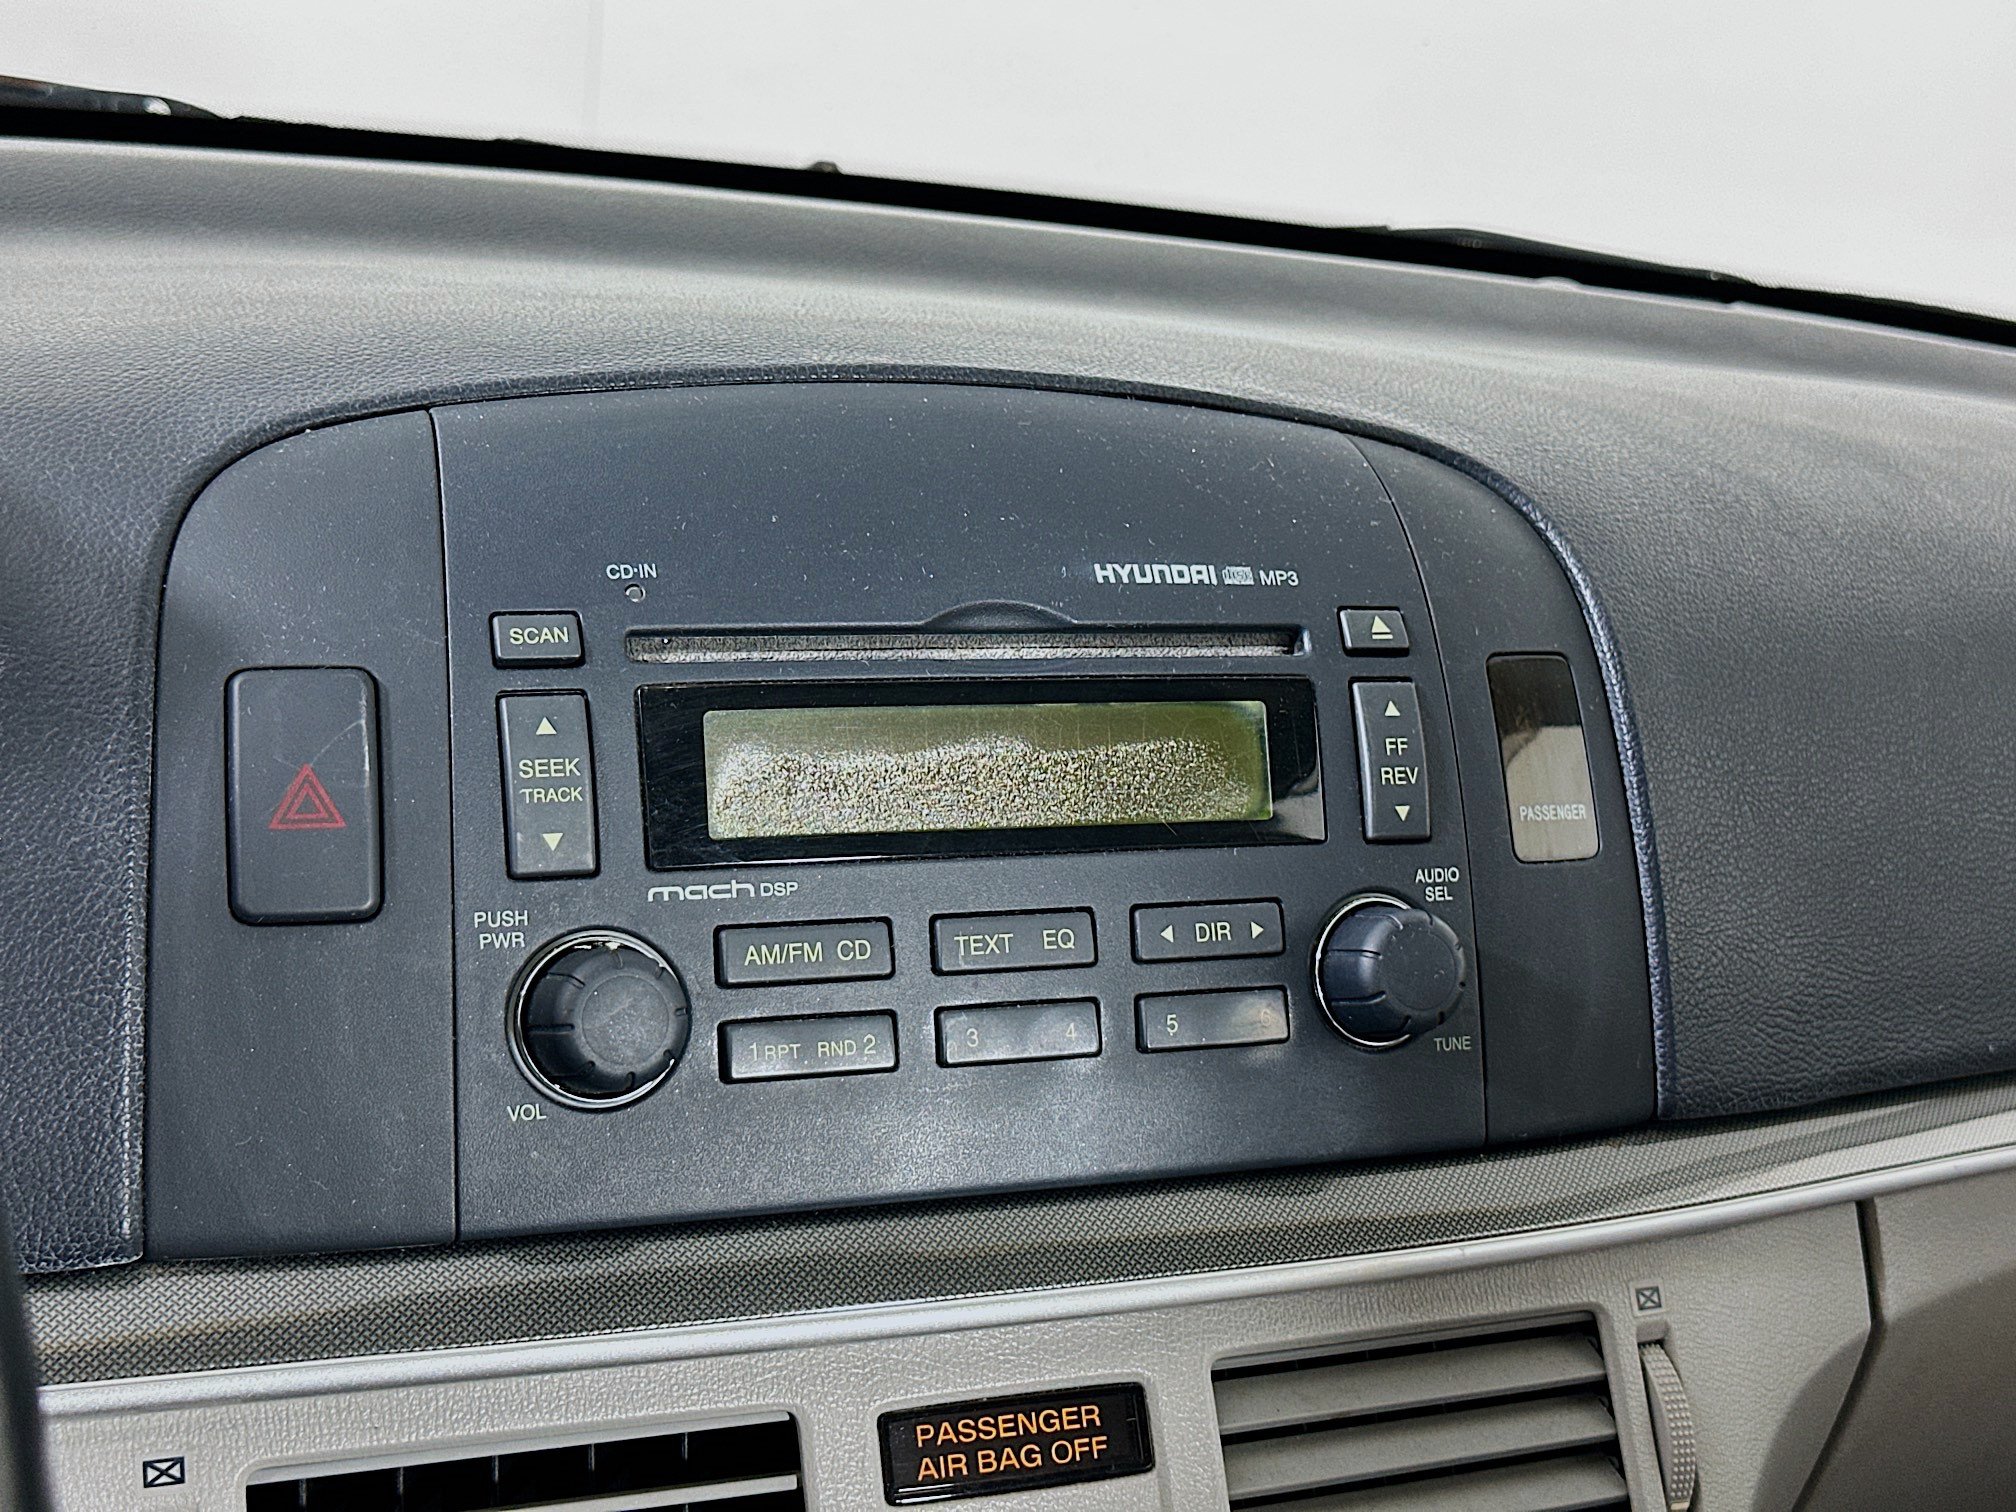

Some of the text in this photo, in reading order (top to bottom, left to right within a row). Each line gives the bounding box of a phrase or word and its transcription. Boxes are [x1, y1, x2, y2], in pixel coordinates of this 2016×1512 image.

[1094, 563, 1217, 586] HYUNDAI
[1259, 570, 1299, 586] MP3
[509, 627, 570, 644] SCAN
[1385, 738, 1408, 755] FF
[519, 758, 581, 778] SEEK
[1380, 767, 1419, 785] REV
[521, 787, 583, 804] TRACK
[1519, 804, 1587, 822] PASSENGER
[1415, 867, 1460, 883] AUDIO
[647, 880, 799, 902] mach DSP
[1425, 886, 1453, 902] SEL
[474, 911, 529, 928] PUSH
[480, 932, 525, 949] PWR
[954, 928, 1076, 956] TEXT EQ
[1195, 922, 1233, 944] DIR
[744, 940, 871, 966] AM/FM CD
[1166, 1014, 1178, 1033] 5
[966, 1022, 1077, 1047] 3 4
[817, 1040, 857, 1057] RND
[863, 1034, 876, 1055] 2
[1434, 1036, 1471, 1052] TUNE
[507, 1105, 547, 1121] VOL
[916, 1404, 1101, 1447] PASSENGER
[917, 1435, 1108, 1481] AIR BAG OFF
